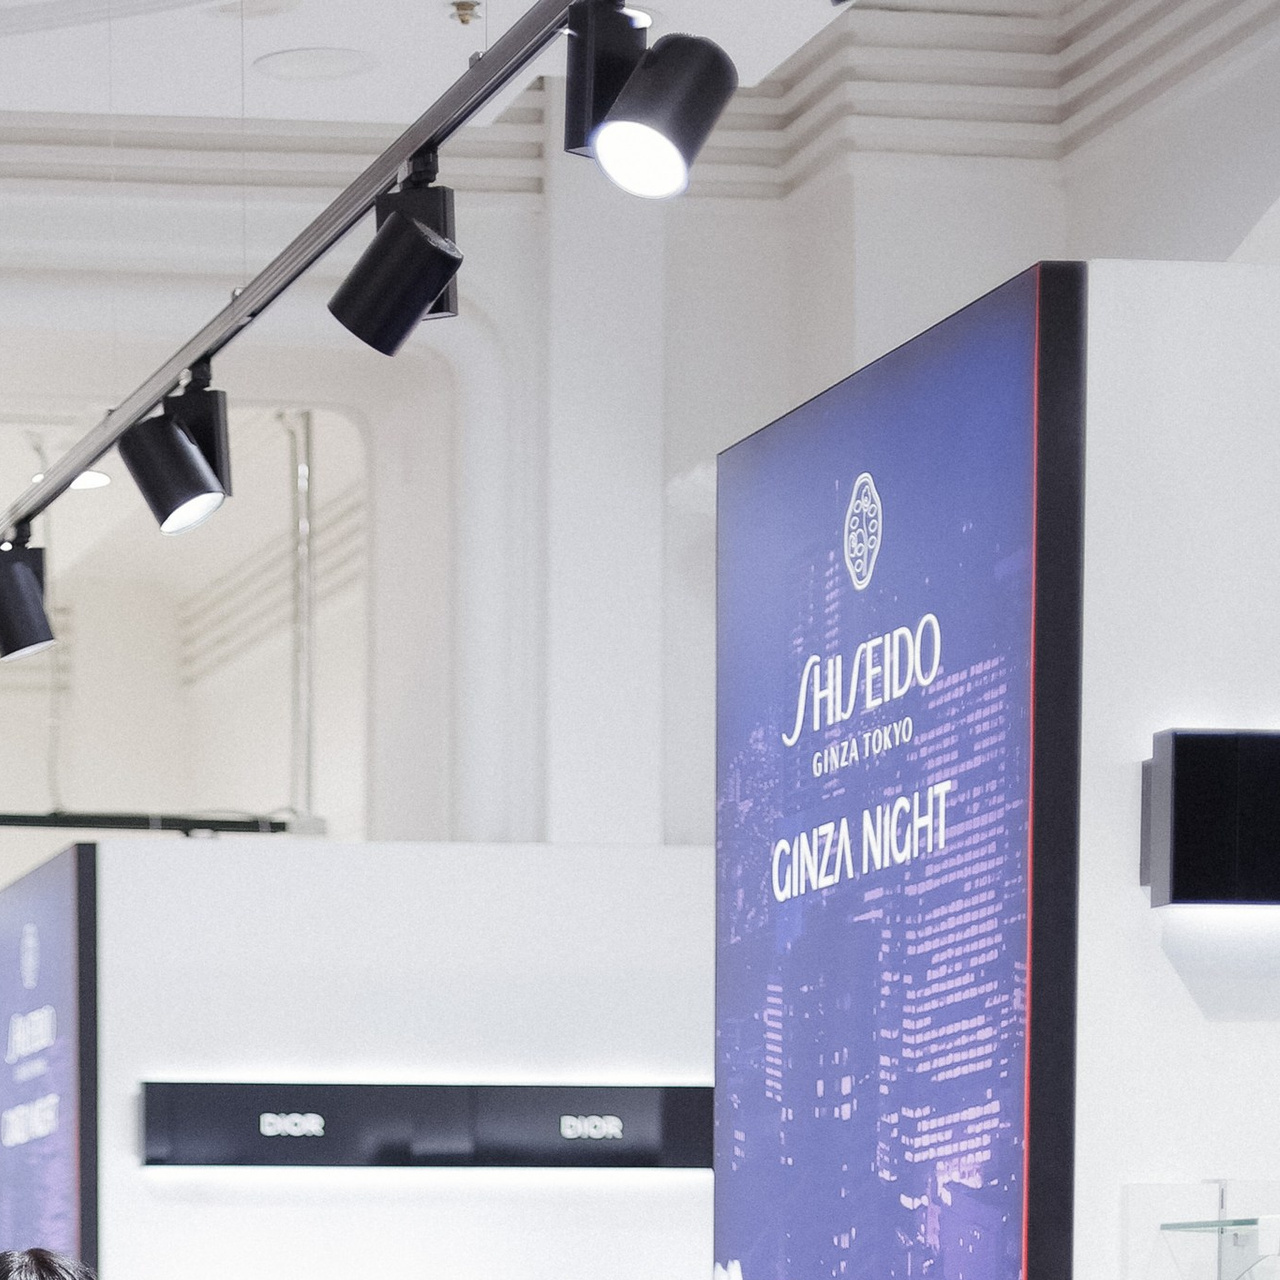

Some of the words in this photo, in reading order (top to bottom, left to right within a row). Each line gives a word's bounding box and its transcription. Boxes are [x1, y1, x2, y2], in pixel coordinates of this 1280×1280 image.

[782, 613, 941, 747] SHISEIDO
[812, 738, 860, 778] GINZA
[863, 716, 914, 758] TOKYO
[772, 817, 854, 902] GINZA
[862, 780, 952, 876] NIGHT
[259, 1112, 325, 1137] DIOR
[559, 1114, 624, 1139] DIOR
